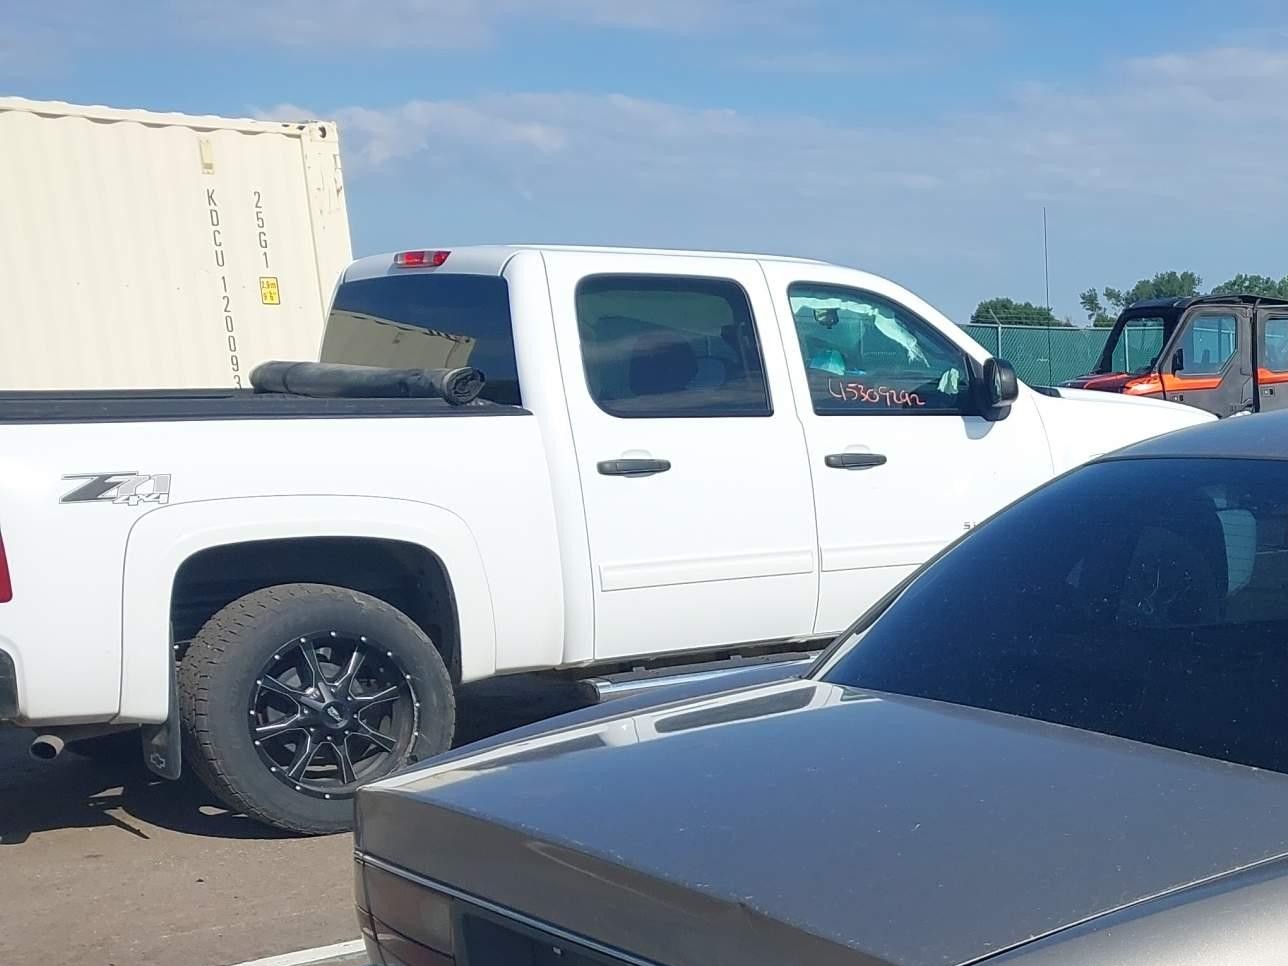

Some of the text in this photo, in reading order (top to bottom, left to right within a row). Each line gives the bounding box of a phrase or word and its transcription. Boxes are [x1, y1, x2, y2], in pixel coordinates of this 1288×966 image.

[206, 188, 226, 268] KDCU
[253, 190, 270, 269] 25G1
[59, 471, 171, 505] Z71
